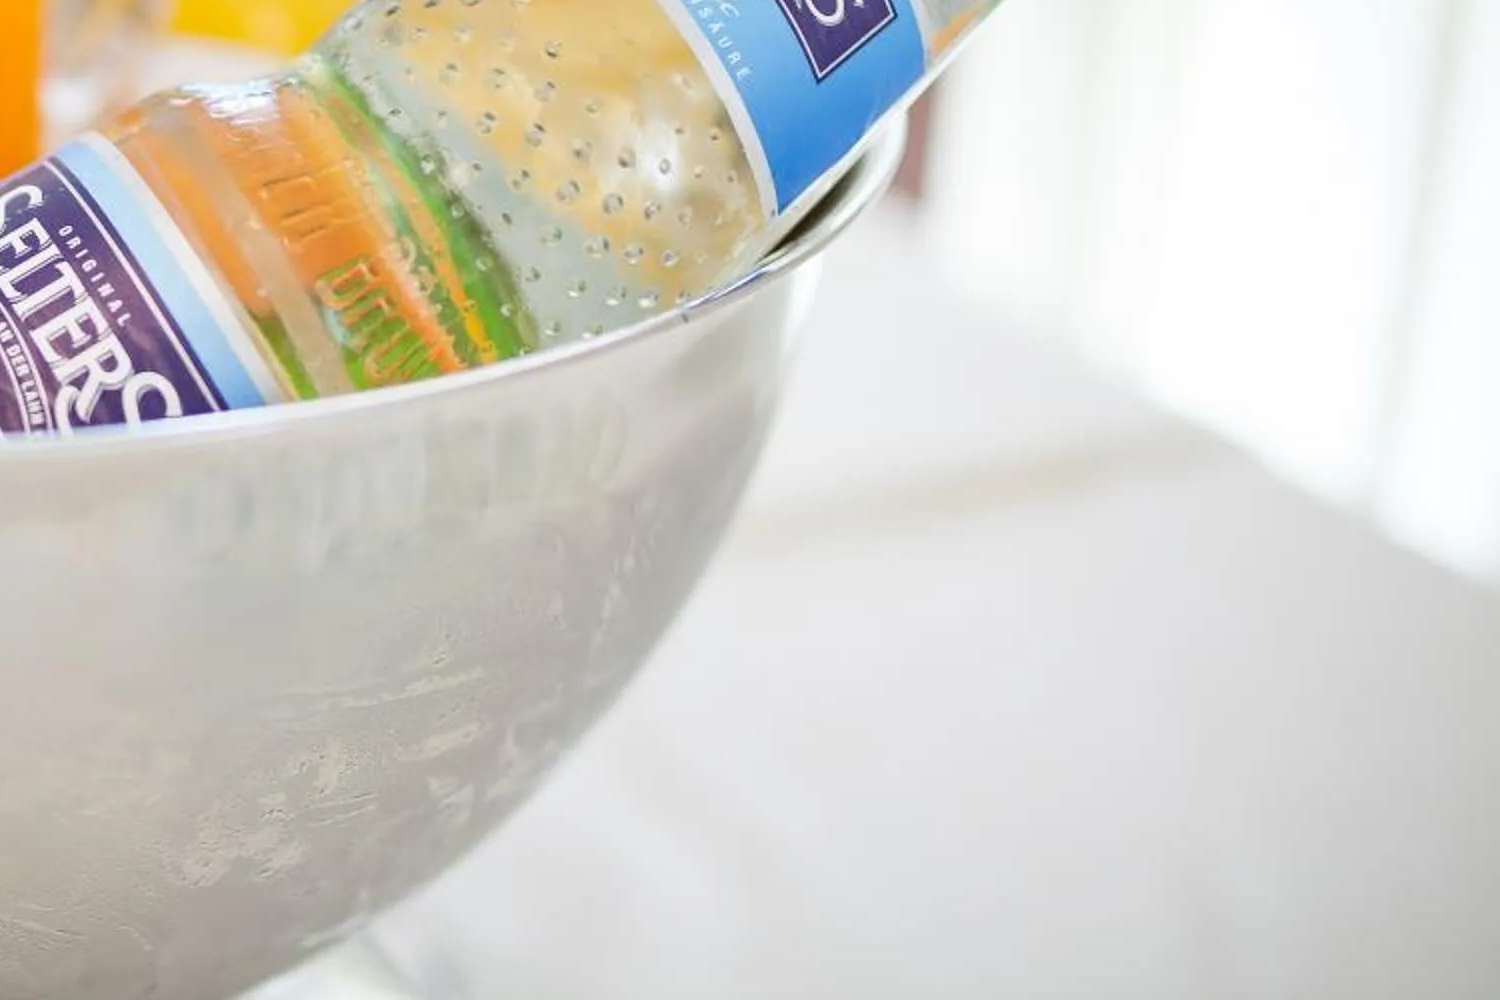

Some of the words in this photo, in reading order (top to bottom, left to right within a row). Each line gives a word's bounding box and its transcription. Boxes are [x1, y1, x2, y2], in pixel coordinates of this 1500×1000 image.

[57, 225, 132, 327] ORIGINAL
[5, 343, 31, 378] DER
[20, 379, 46, 426] LAHN
